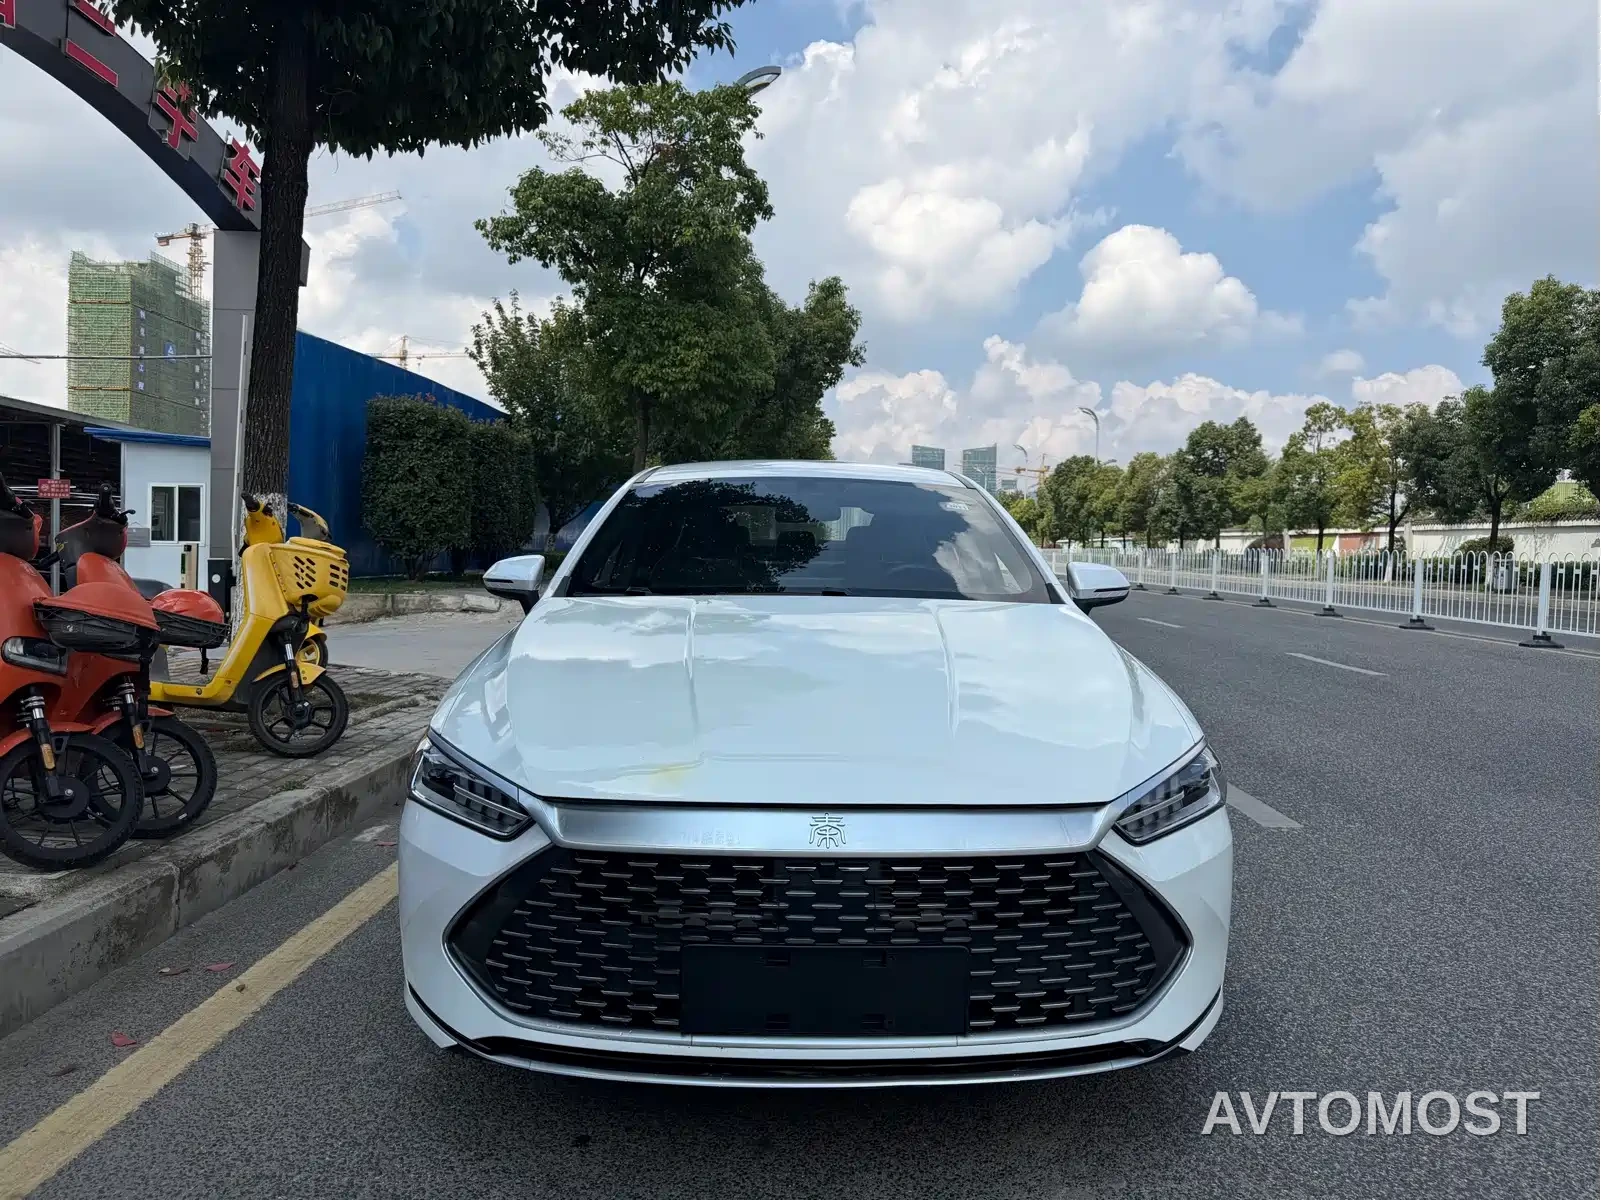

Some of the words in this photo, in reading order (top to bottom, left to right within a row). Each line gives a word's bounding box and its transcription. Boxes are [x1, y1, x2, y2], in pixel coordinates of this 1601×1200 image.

[0, 0, 261, 211] 二手车
[808, 812, 847, 849] 秦
